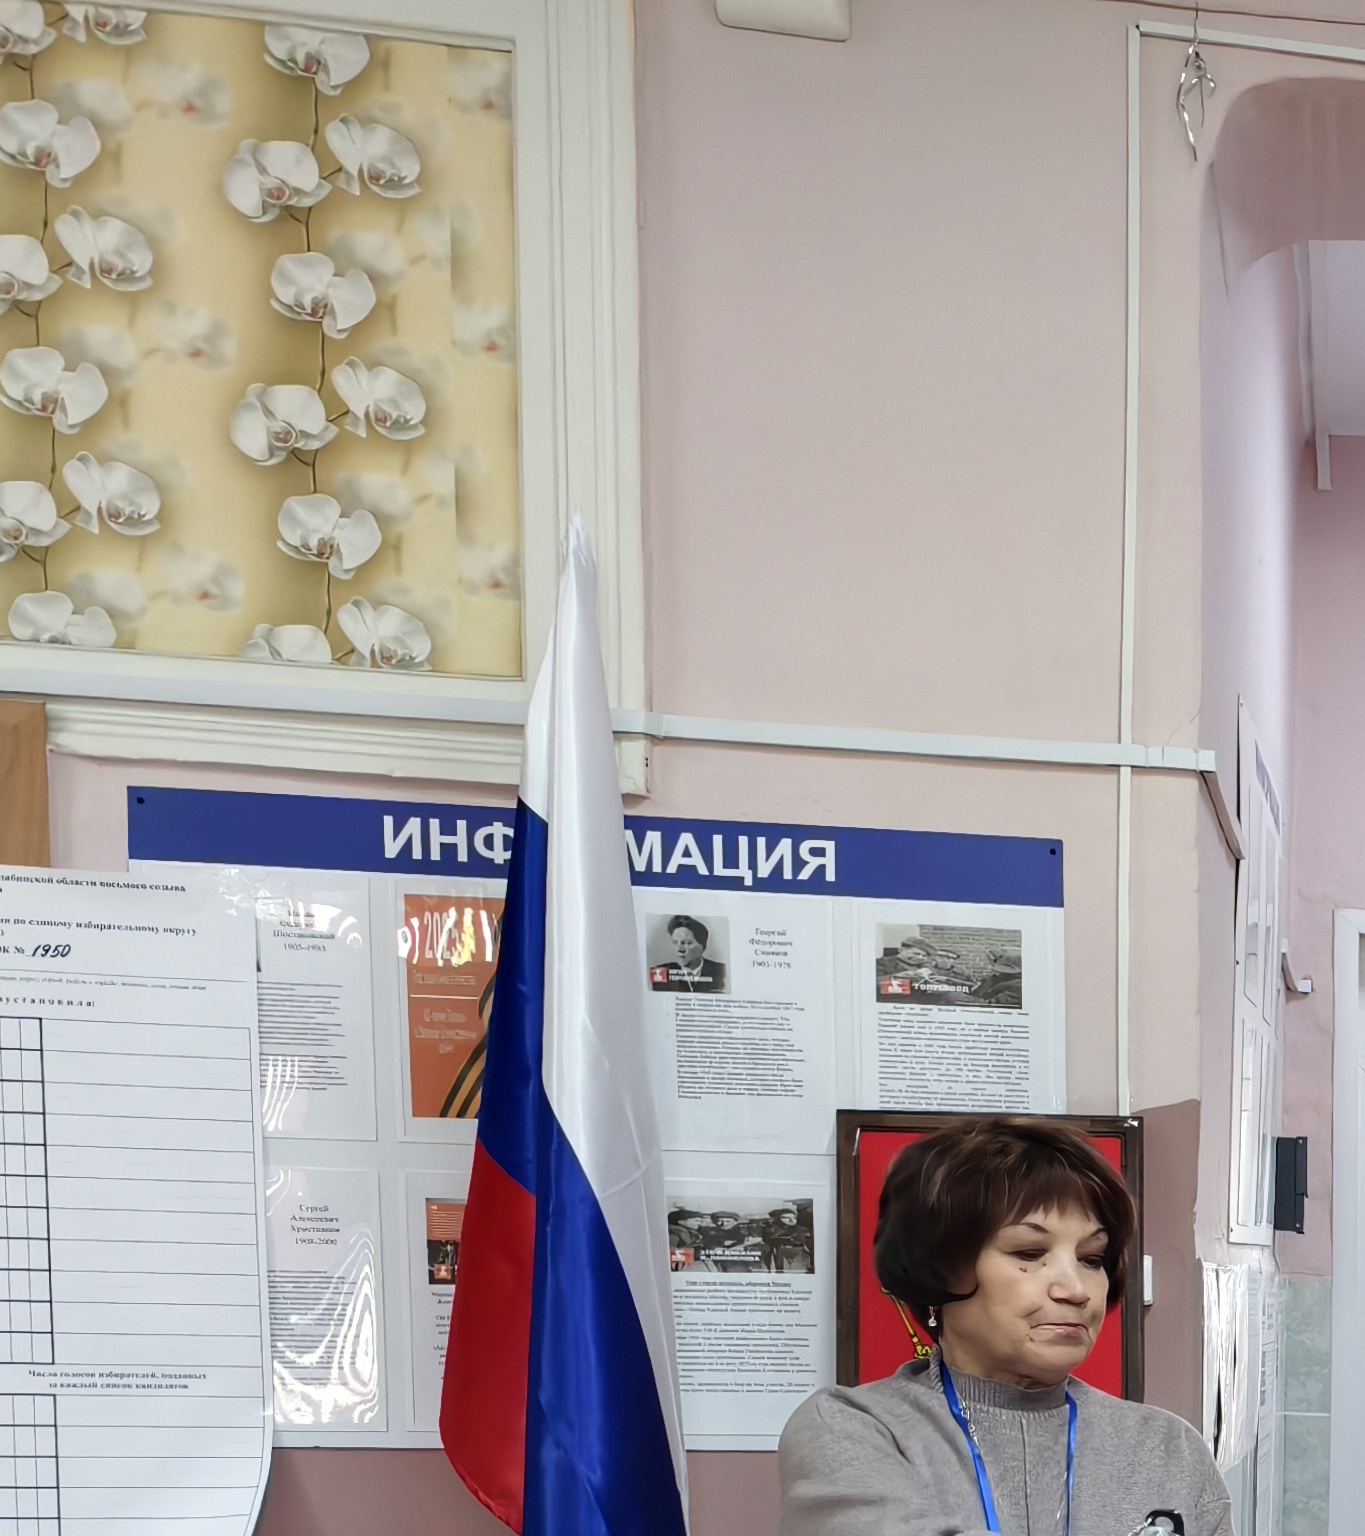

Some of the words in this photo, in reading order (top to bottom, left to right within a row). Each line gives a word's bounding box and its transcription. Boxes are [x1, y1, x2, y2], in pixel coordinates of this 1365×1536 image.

[383, 815, 836, 886] ИНФМАЦИЯ
[13, 918, 27, 926] по
[32, 943, 72, 958] 1950
